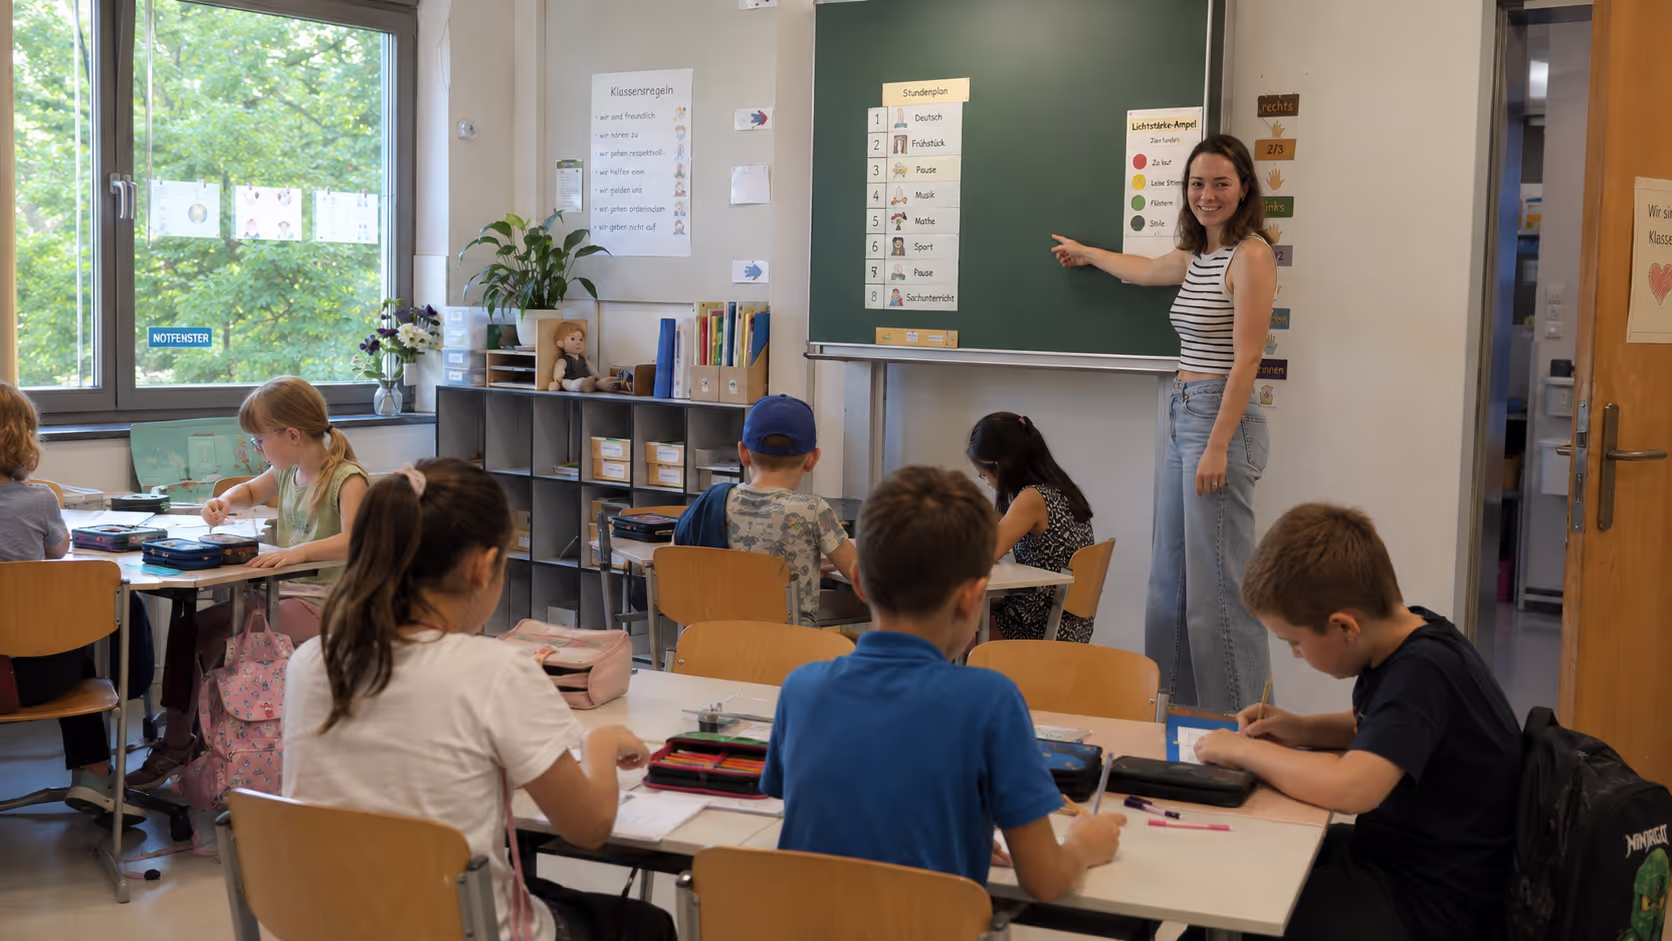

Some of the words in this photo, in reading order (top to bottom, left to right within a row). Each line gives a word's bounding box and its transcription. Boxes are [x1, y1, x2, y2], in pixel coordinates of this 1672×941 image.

[902, 86, 949, 98] Stundenplan
[1262, 100, 1293, 112] rechts
[624, 111, 656, 120] freundlich
[875, 113, 880, 125] 1
[914, 112, 943, 122] Deutsch
[873, 139, 880, 151] 2
[911, 138, 945, 148] Frühstück
[1267, 144, 1284, 155] 2/3
[873, 164, 880, 176] 3
[915, 165, 937, 175] Pause
[872, 190, 879, 201] 4
[914, 191, 935, 199] Musik
[1648, 204, 1662, 218] Wir
[872, 215, 879, 227] 5
[914, 217, 935, 225] Mathe
[871, 240, 878, 252] 6
[914, 242, 934, 253] Sport
[913, 268, 934, 277] Pause
[871, 290, 877, 302] 8
[153, 332, 209, 344] NOTFENSTER
